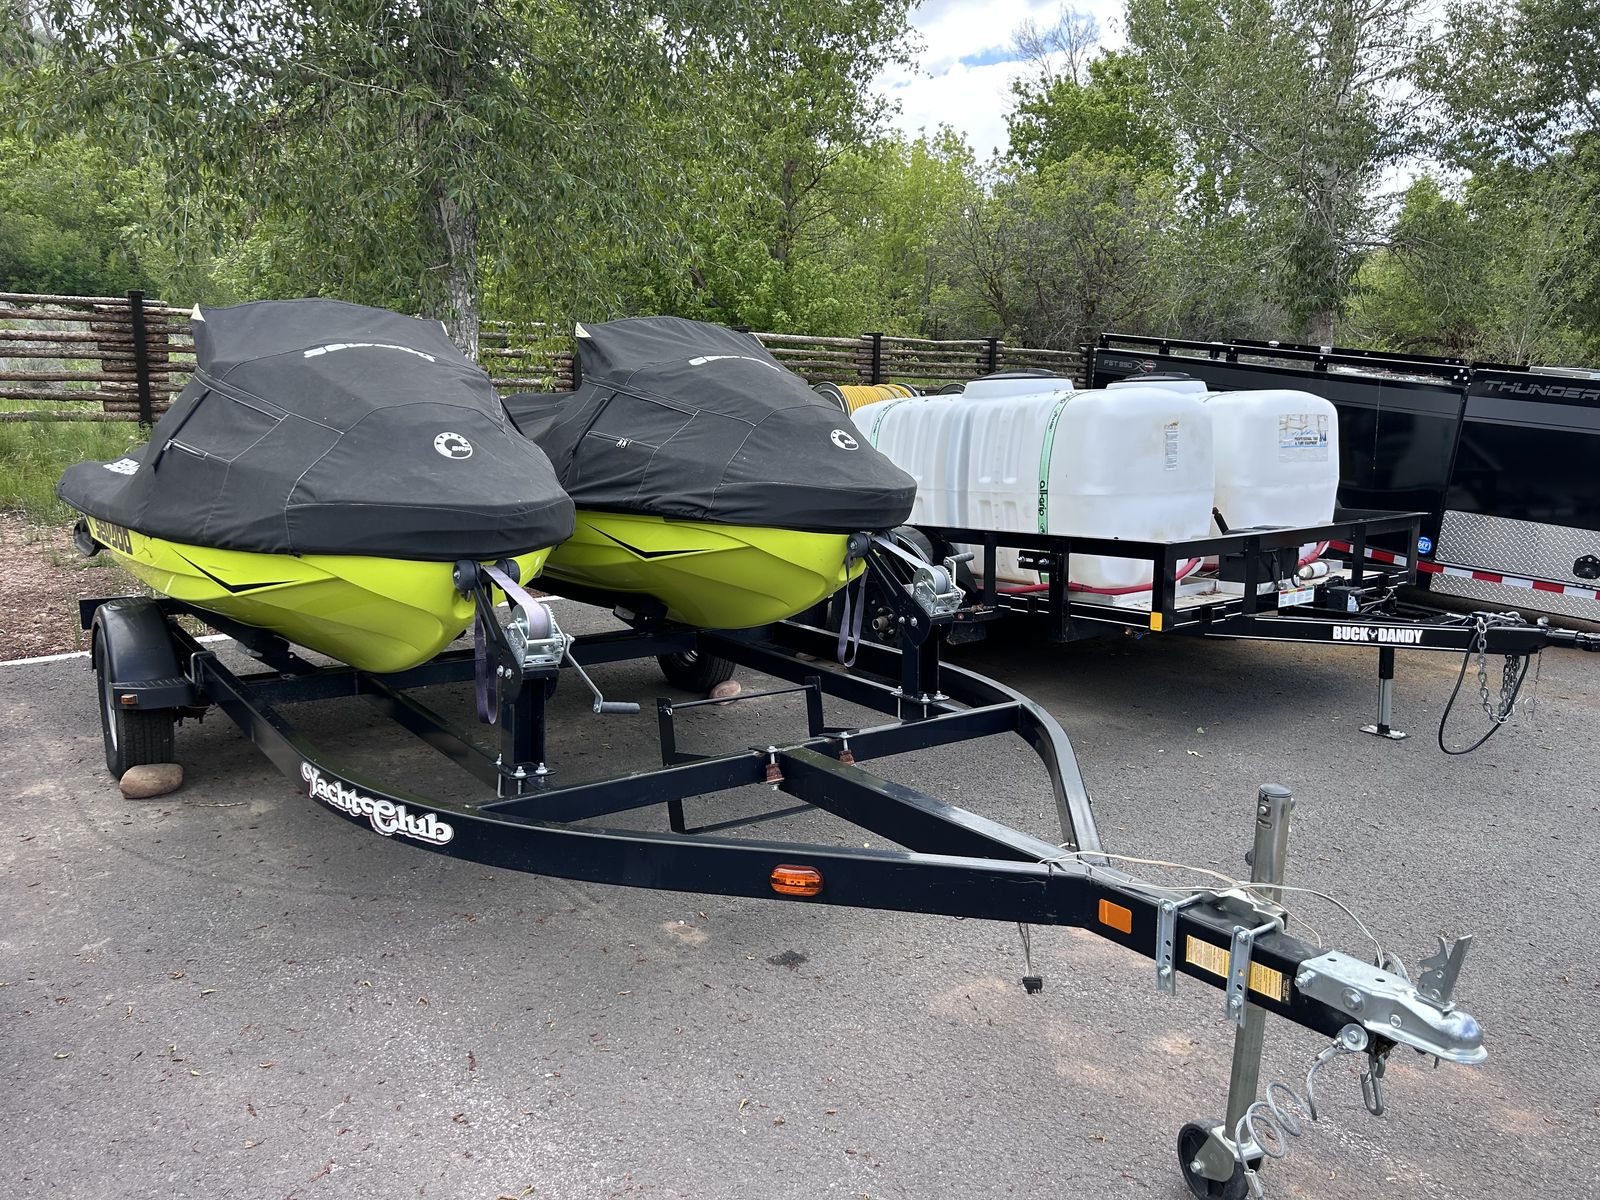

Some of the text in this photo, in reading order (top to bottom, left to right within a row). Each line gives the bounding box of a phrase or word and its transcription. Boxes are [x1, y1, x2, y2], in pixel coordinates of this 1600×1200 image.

[1484, 380, 1600, 400] THUNDER
[1332, 625, 1424, 644] BUCK DANDY
